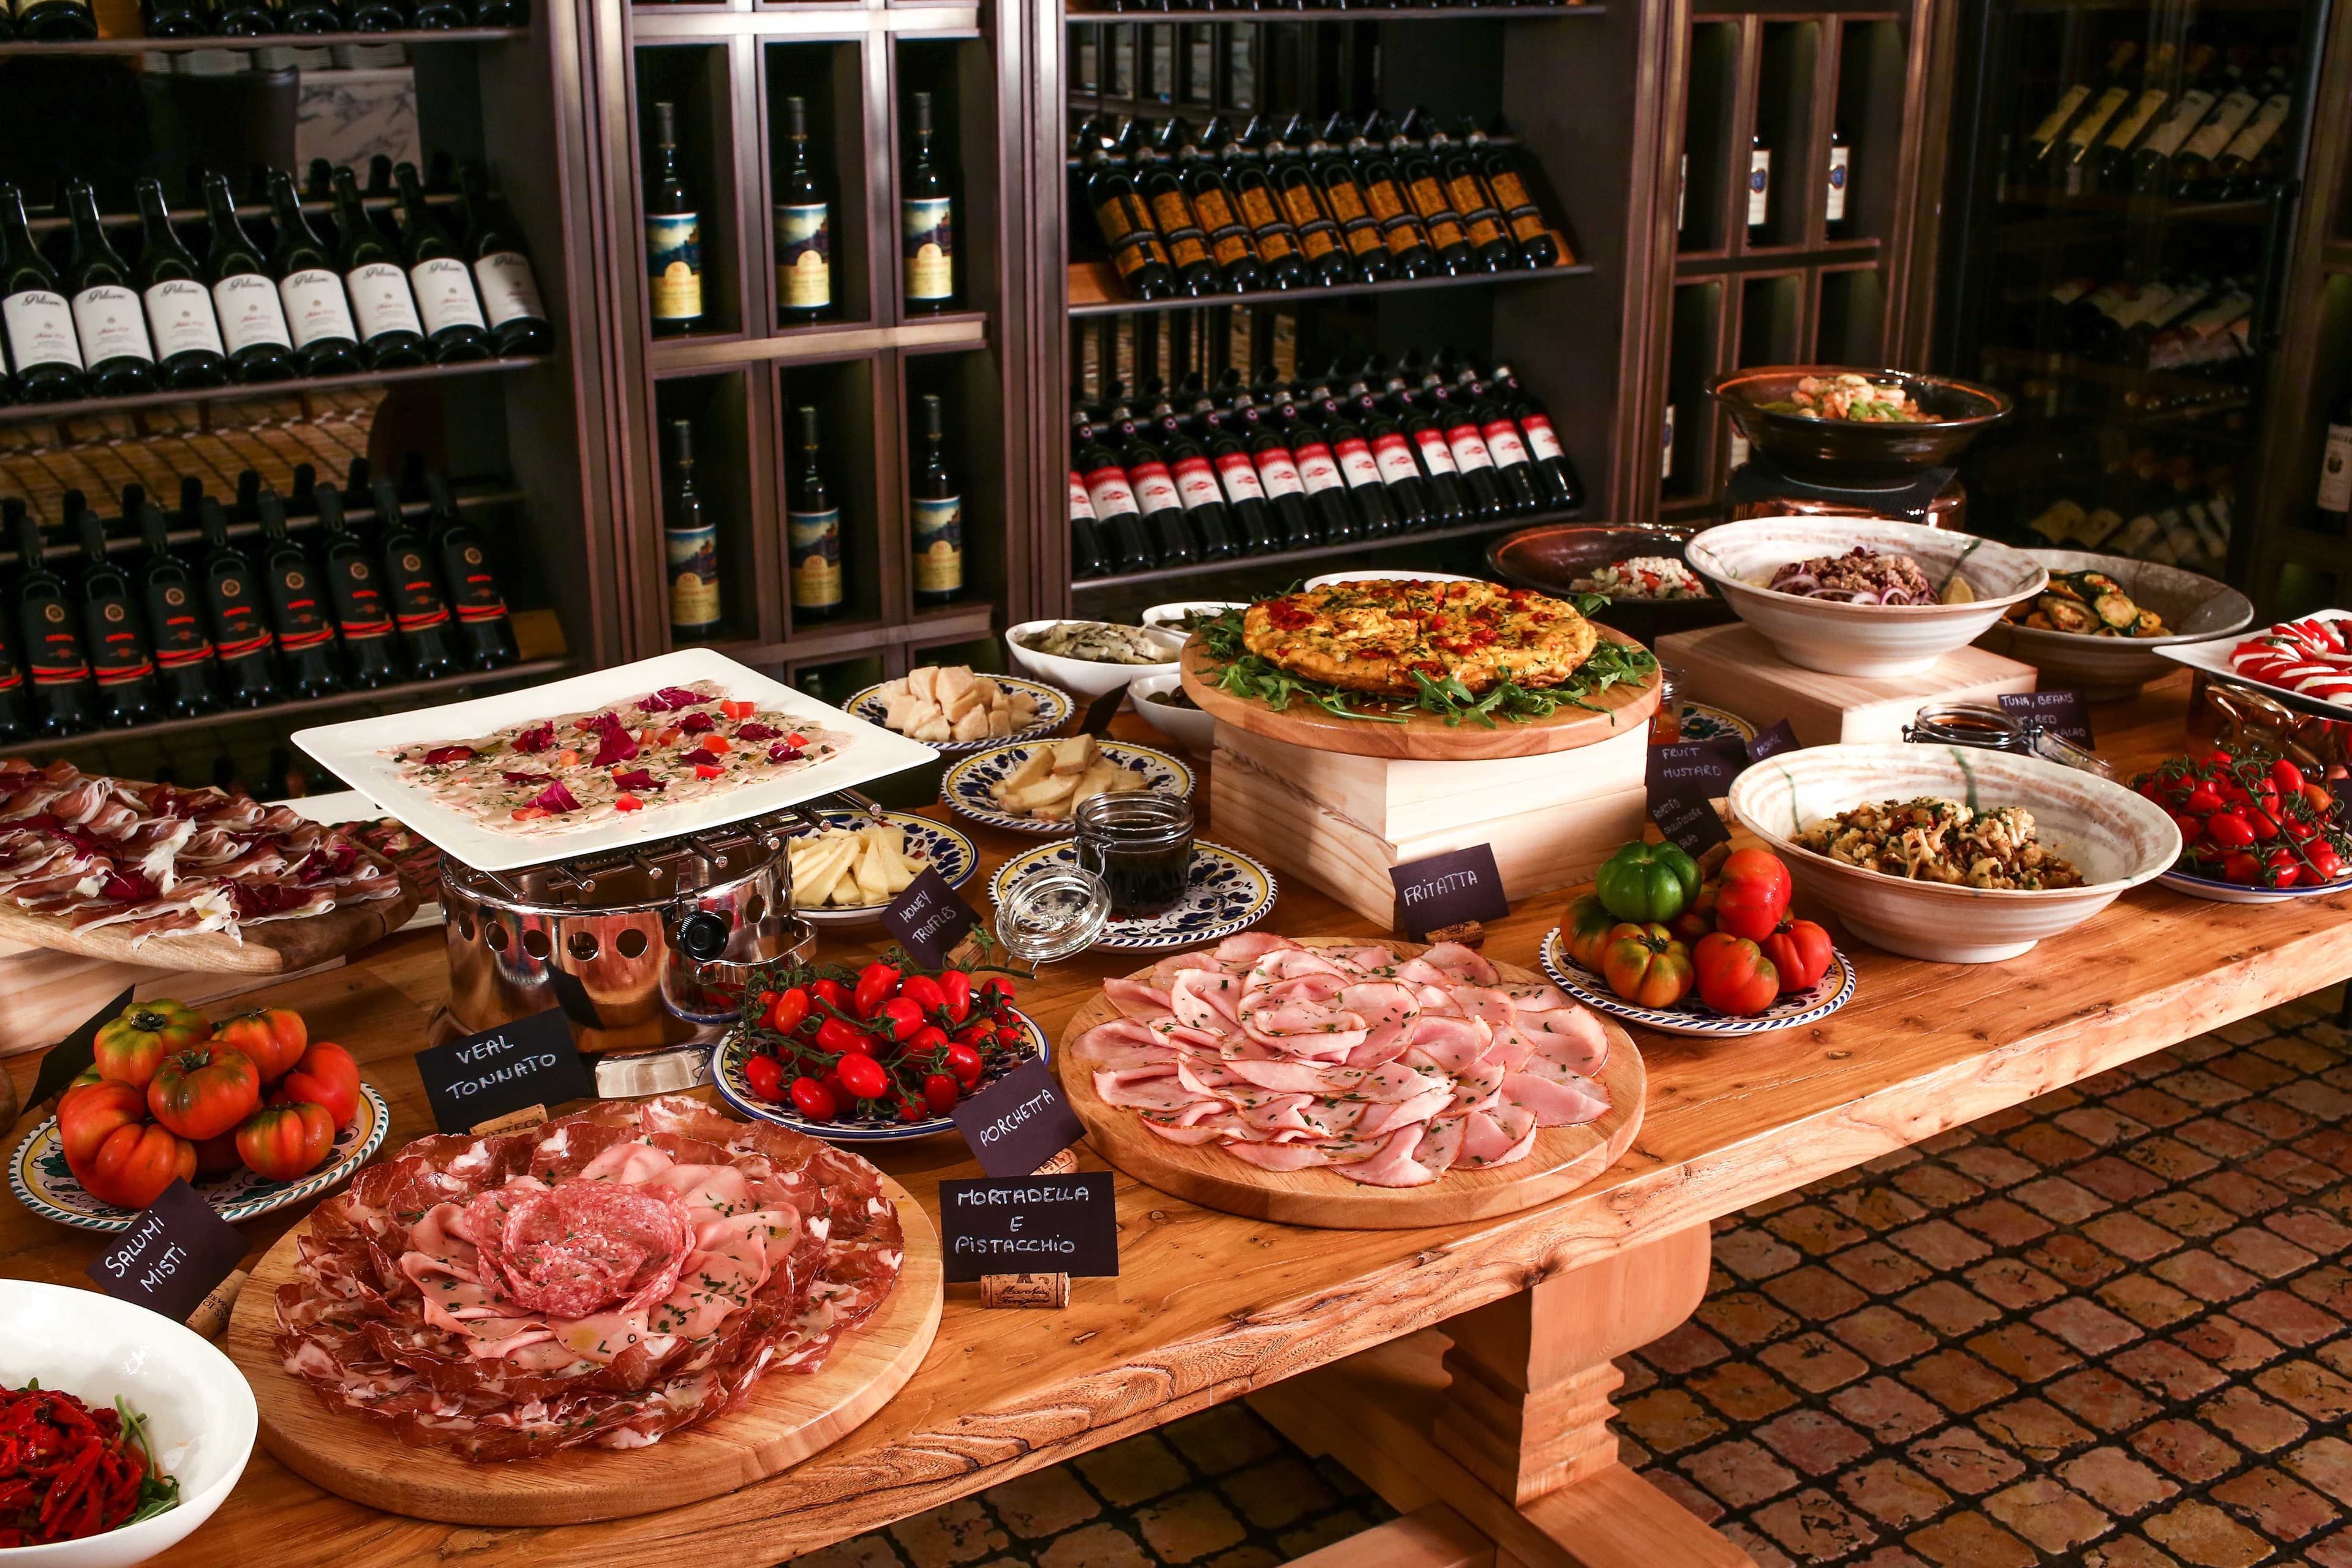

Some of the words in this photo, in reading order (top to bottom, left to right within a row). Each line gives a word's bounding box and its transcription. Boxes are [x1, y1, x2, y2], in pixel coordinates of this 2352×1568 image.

[2000, 695, 2035, 709] TUNA,
[2037, 693, 2074, 706] BEANS
[2035, 714, 2057, 724] RED
[1662, 747, 1701, 760] FRUIT
[1663, 764, 1722, 778] MUSTARD
[1404, 870, 1478, 907] FRITATTA
[899, 890, 932, 923] HONEY
[912, 906, 957, 944] TRUFFLES
[455, 1035, 514, 1065] VEAL
[445, 1054, 557, 1099] TONNATO
[980, 1088, 1055, 1147] PORCHETTA
[957, 1186, 1090, 1207] MORTADELLA
[1009, 1216, 1024, 1232] E
[105, 1210, 165, 1278] SALUMI
[955, 1234, 1076, 1254] PISTACCHIO
[140, 1242, 187, 1293] MISTI
